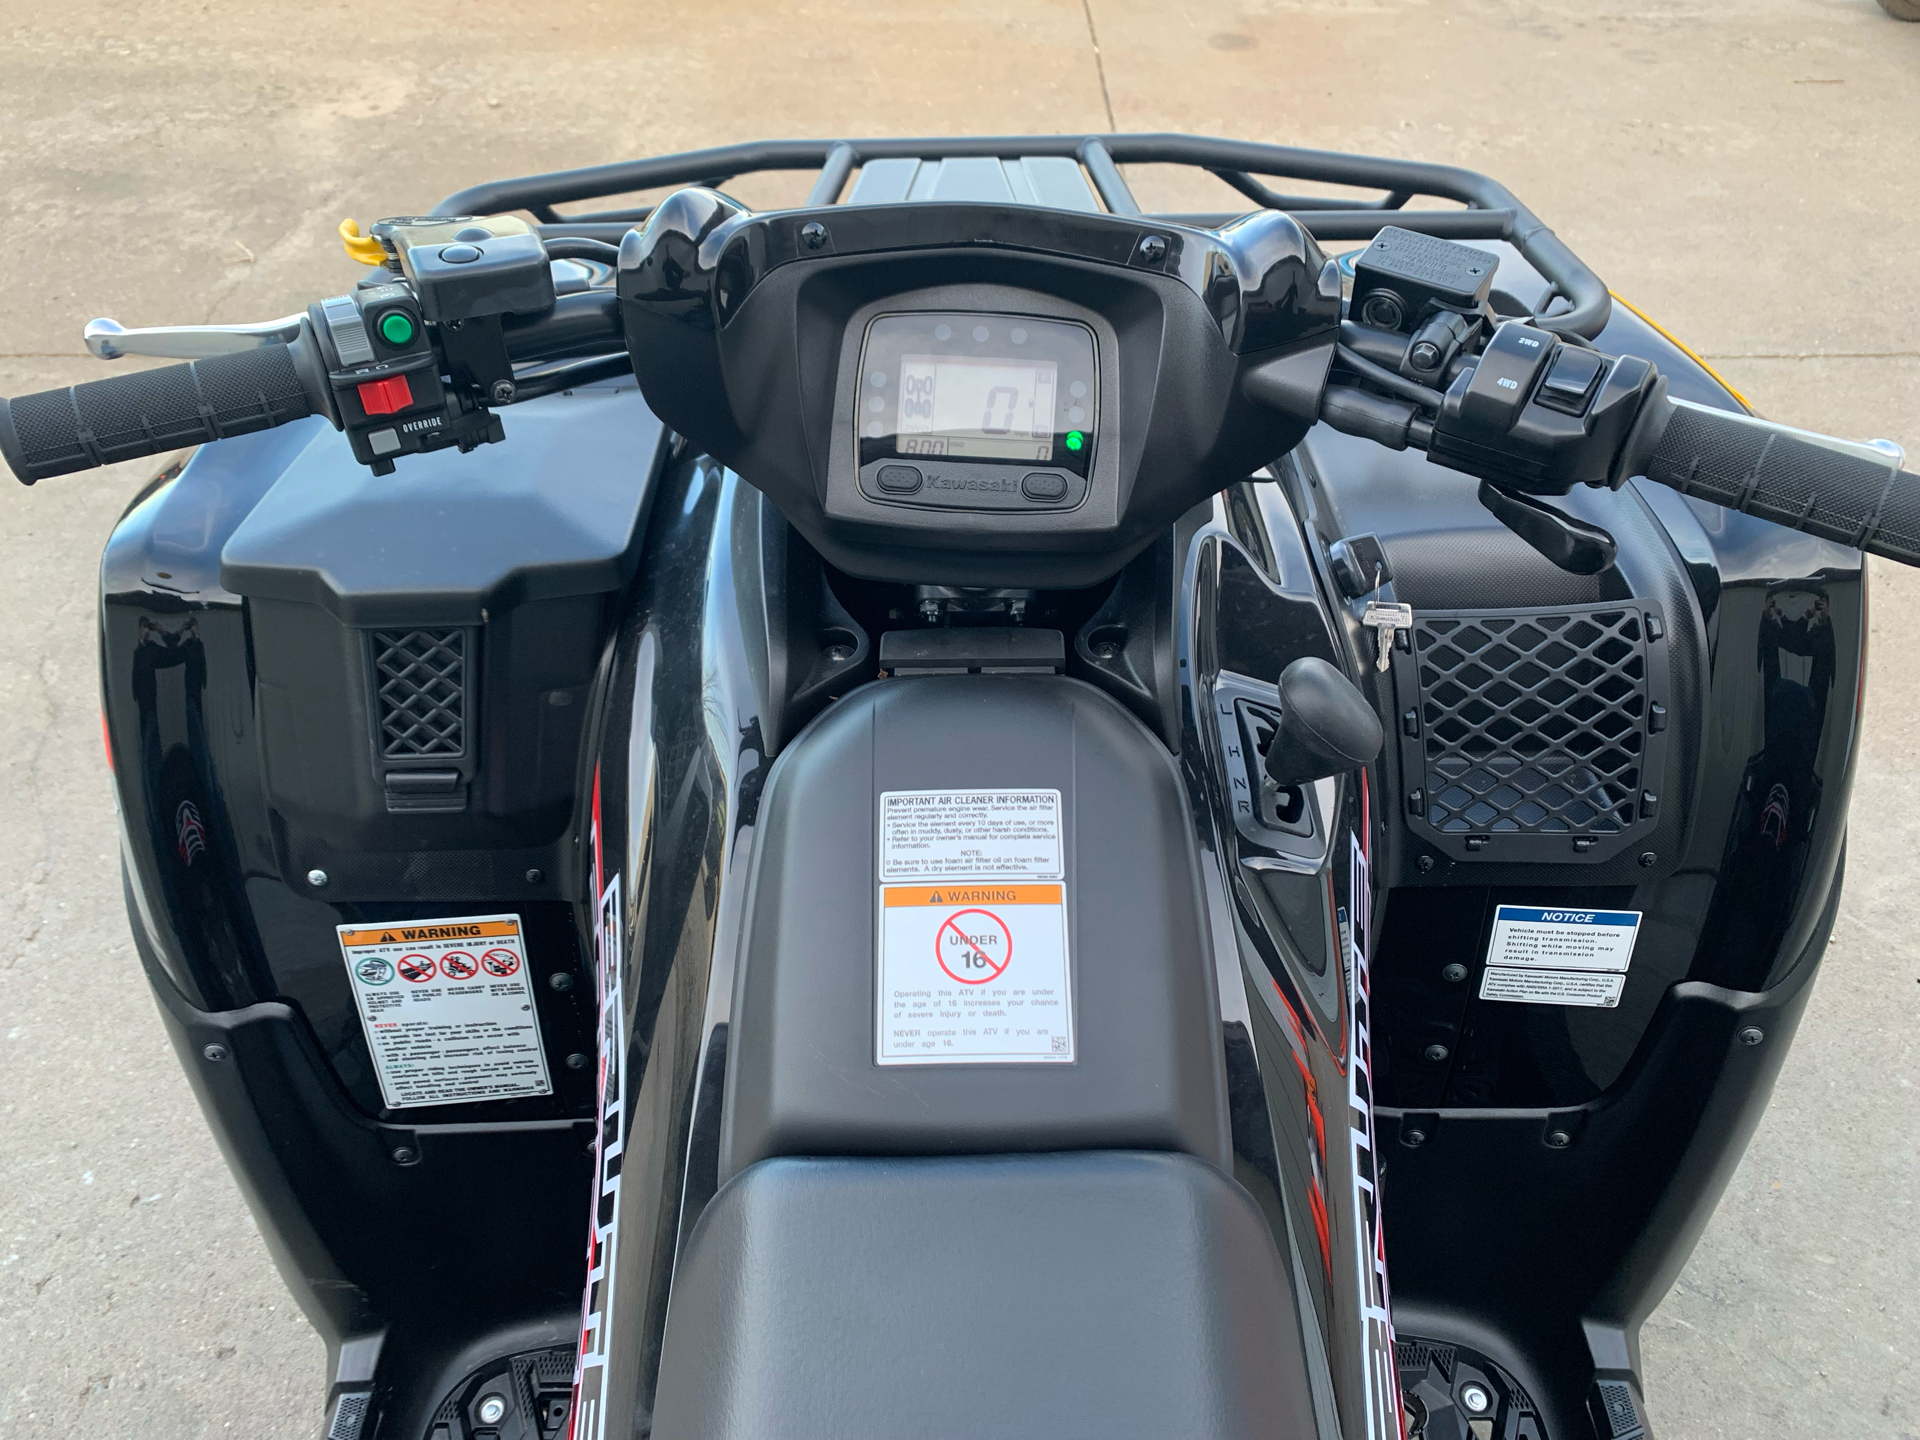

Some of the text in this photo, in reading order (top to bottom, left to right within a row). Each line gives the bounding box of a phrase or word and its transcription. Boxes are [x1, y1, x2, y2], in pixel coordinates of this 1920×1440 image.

[1518, 337, 1539, 347] 2WD
[1497, 377, 1518, 389] 4WD
[981, 385, 1019, 435] 0
[403, 417, 442, 433] OVERRIDE
[926, 475, 1018, 493] Kawasaki
[887, 795, 1054, 806] IMPORTANT AIR CLEANER INFORMATION
[948, 890, 1016, 901] WARNING
[1541, 912, 1596, 923] NOTICE
[401, 925, 481, 940] WARNING
[949, 935, 998, 945] UNDER
[961, 950, 987, 969] 16
[893, 990, 931, 999] Operating
[939, 1010, 961, 1019] injury
[927, 1029, 956, 1038] operate
